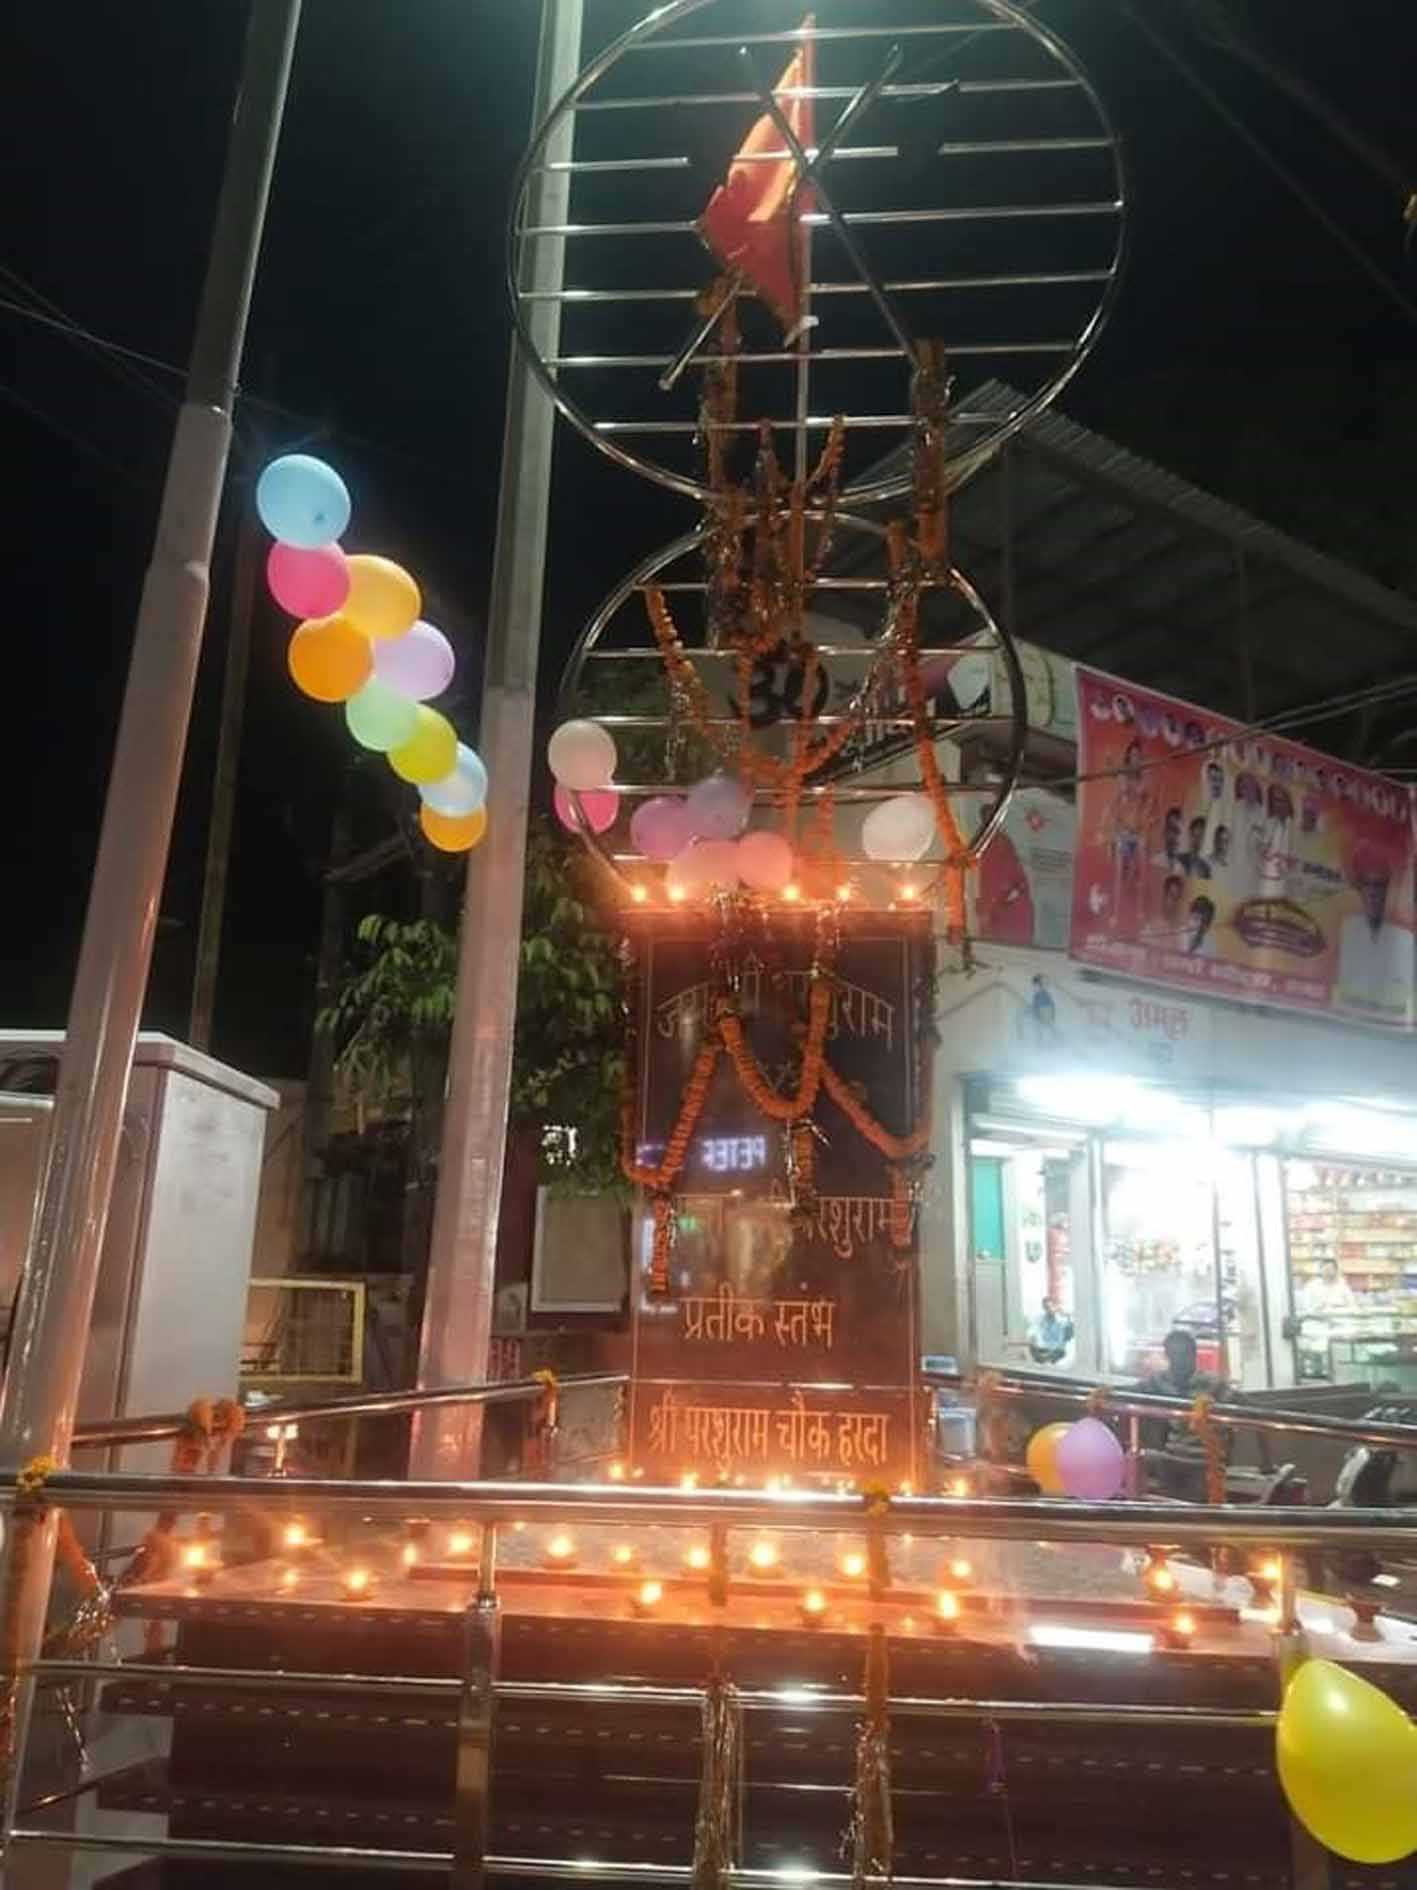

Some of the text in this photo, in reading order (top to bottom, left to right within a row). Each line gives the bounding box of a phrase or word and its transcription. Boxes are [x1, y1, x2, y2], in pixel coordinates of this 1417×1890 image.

[680, 1281, 836, 1348] प्रतीक स्तंभ
[649, 1389, 680, 1452] श्री
[684, 1406, 771, 1472] परशुराम
[835, 1410, 890, 1465] हरदा
